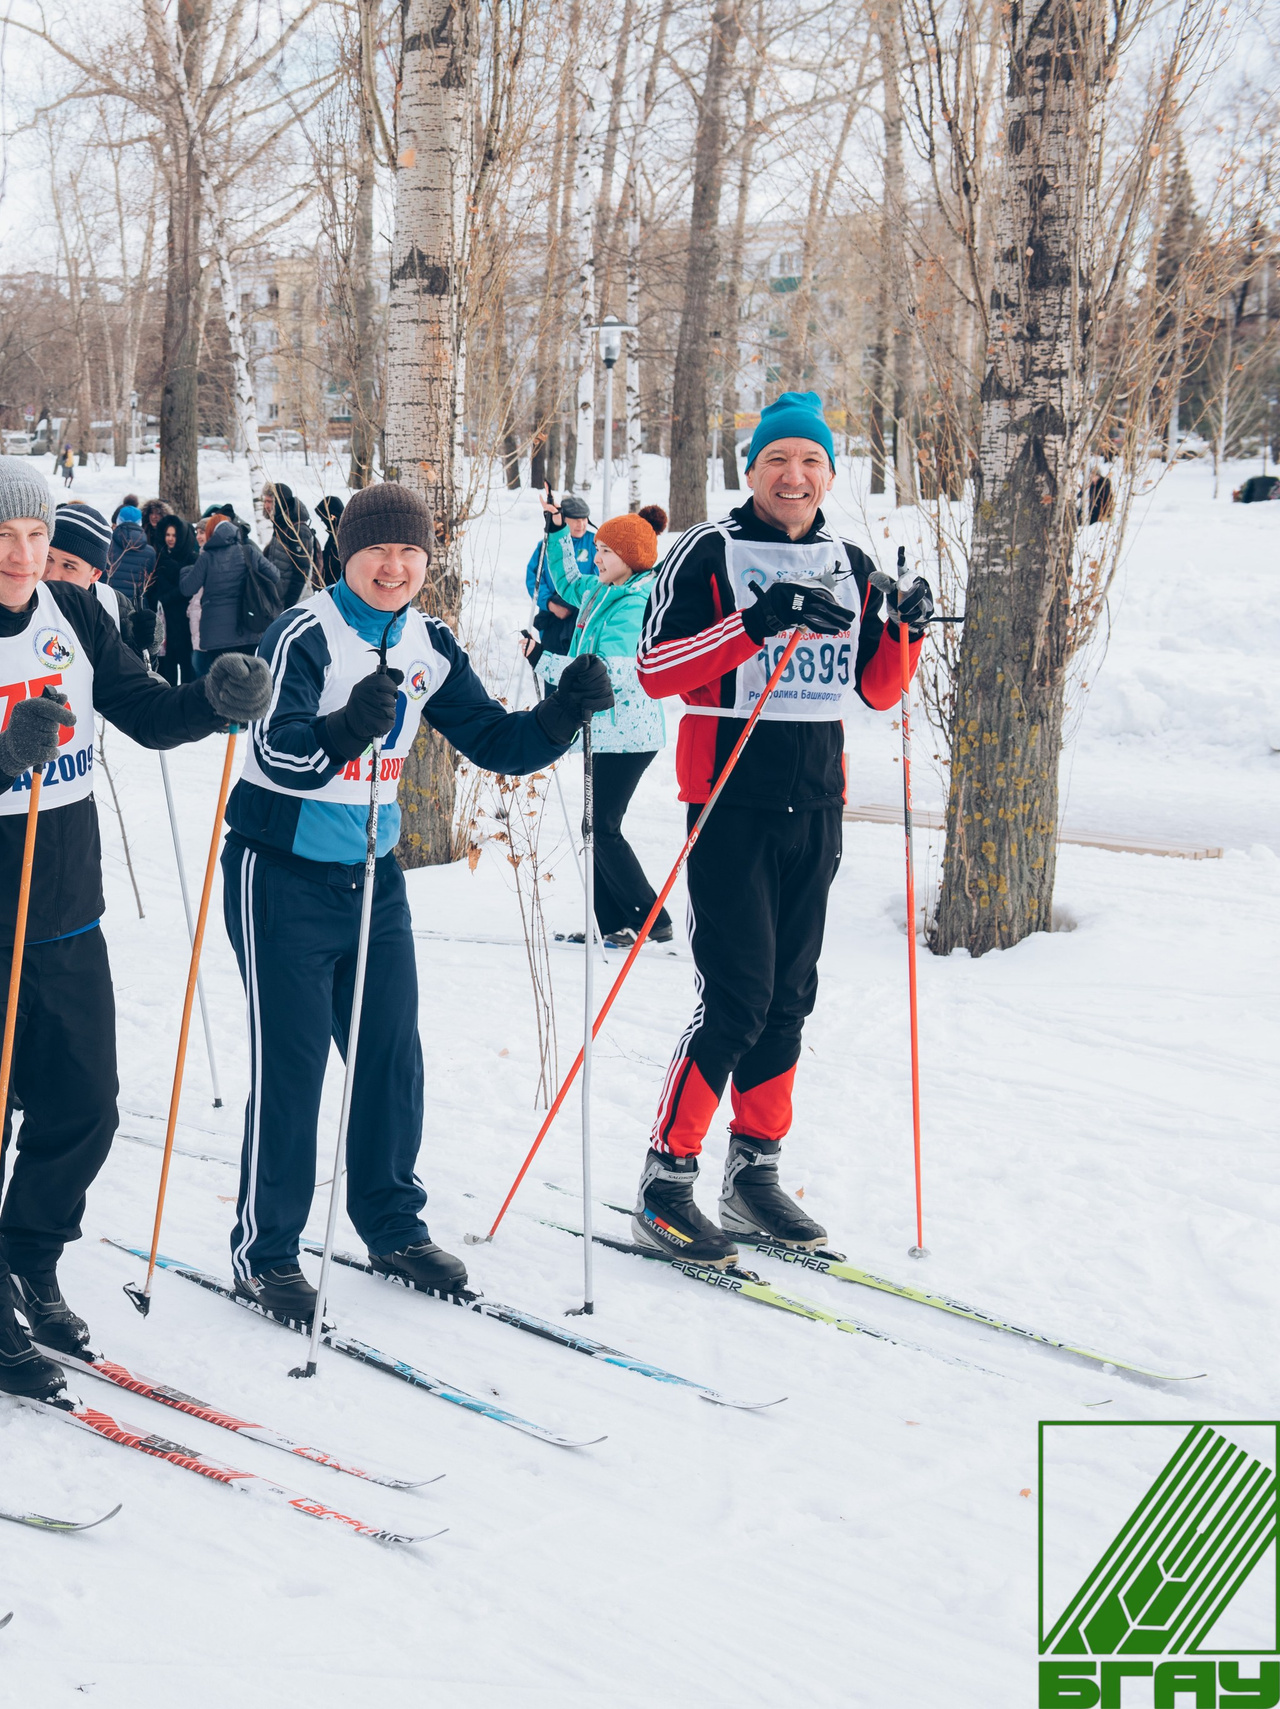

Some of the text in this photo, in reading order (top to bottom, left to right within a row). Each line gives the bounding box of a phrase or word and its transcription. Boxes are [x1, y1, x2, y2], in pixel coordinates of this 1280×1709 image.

[757, 643, 851, 685] 19895
[43, 744, 94, 788] 2009
[642, 1215, 688, 1248] SALOMON
[756, 1243, 830, 1273] FISCHER
[671, 1261, 743, 1292] FISCHER
